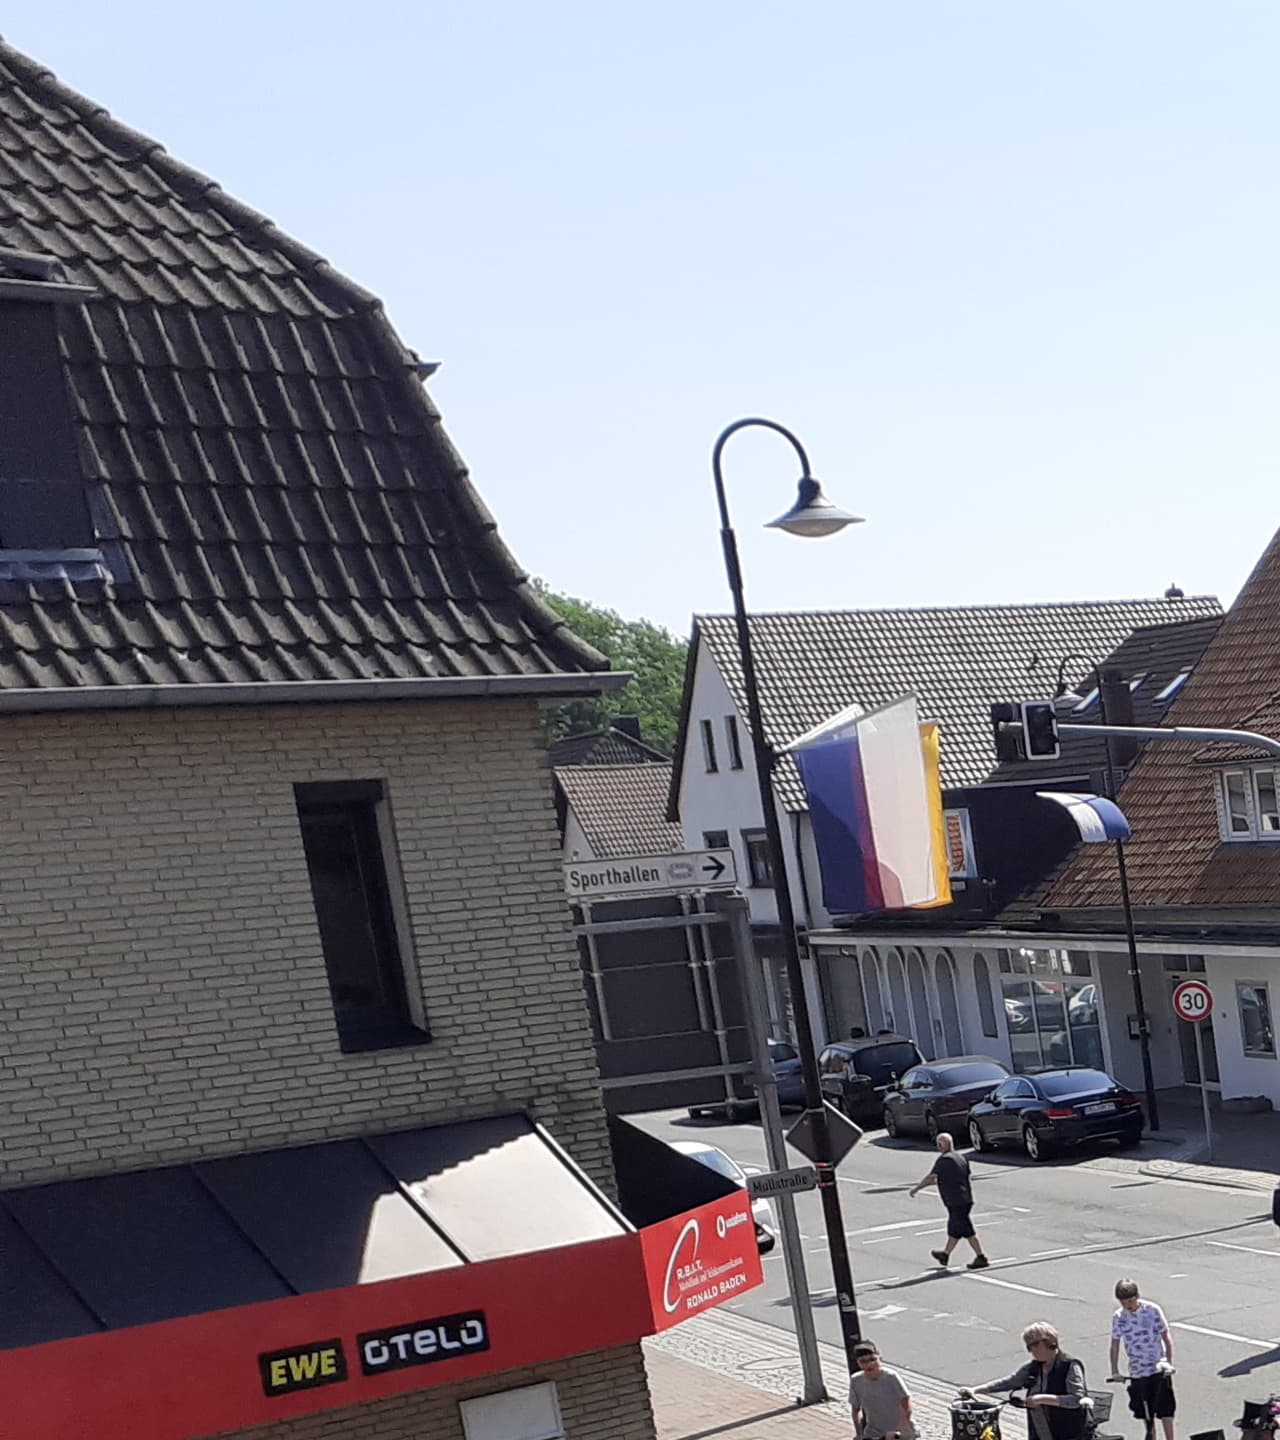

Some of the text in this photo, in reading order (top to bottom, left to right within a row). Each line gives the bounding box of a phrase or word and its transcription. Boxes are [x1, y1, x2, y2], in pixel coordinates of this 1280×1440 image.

[570, 866, 660, 891] Sporthallen
[1182, 993, 1205, 1010] 30
[686, 1286, 719, 1310] RONALD
[719, 1273, 747, 1294] BADEN
[270, 1349, 337, 1387] EWE
